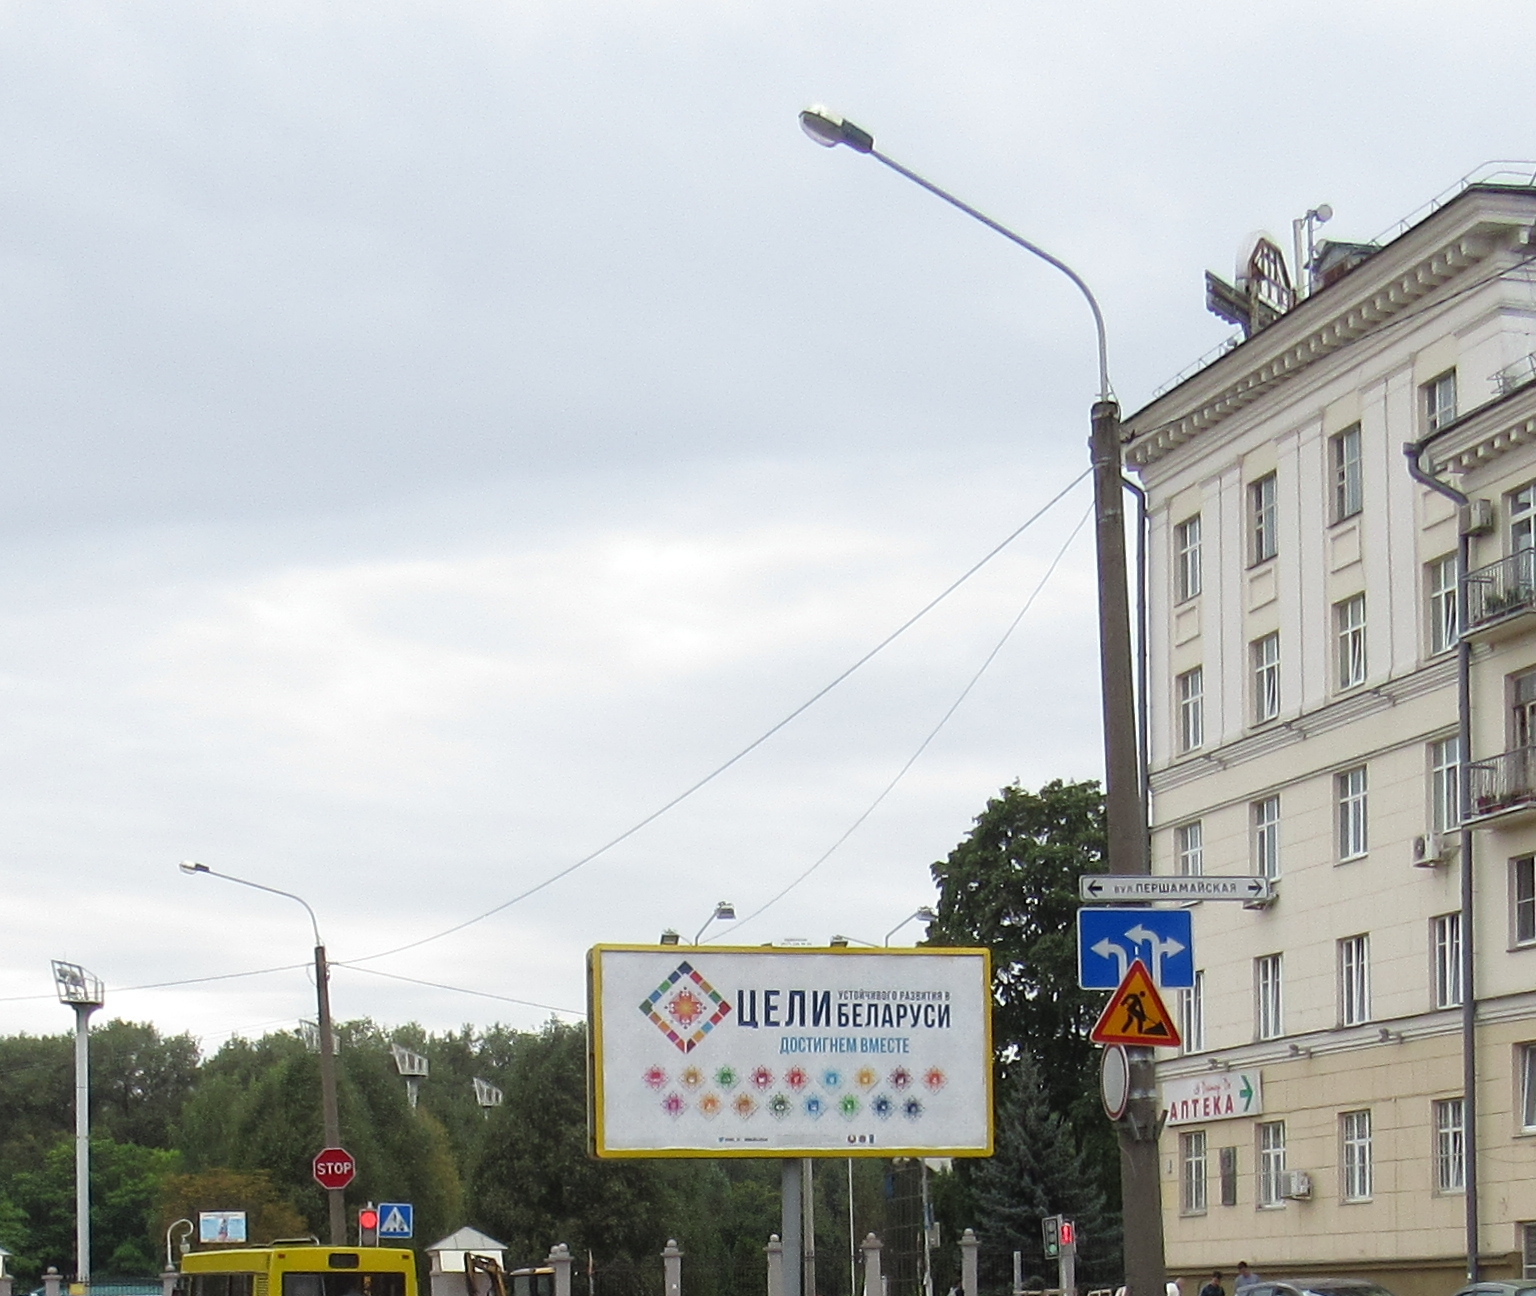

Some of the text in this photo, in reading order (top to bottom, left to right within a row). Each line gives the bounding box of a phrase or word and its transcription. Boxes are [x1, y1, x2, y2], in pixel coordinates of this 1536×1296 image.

[1136, 882, 1237, 893] ПЕРШАМАЙСКАЯ
[838, 989, 951, 1001] УСТОЙЧИВОГО РАЗВИТИЯ В
[737, 989, 831, 1029] ЦЕЛИ
[837, 1003, 951, 1028] БЕЛАРУСИ
[779, 1036, 910, 1055] ДОСТИГНЕМ ВМЕСТЕ
[1170, 1094, 1234, 1121] АПТЕКА
[317, 1162, 351, 1175] STOP
